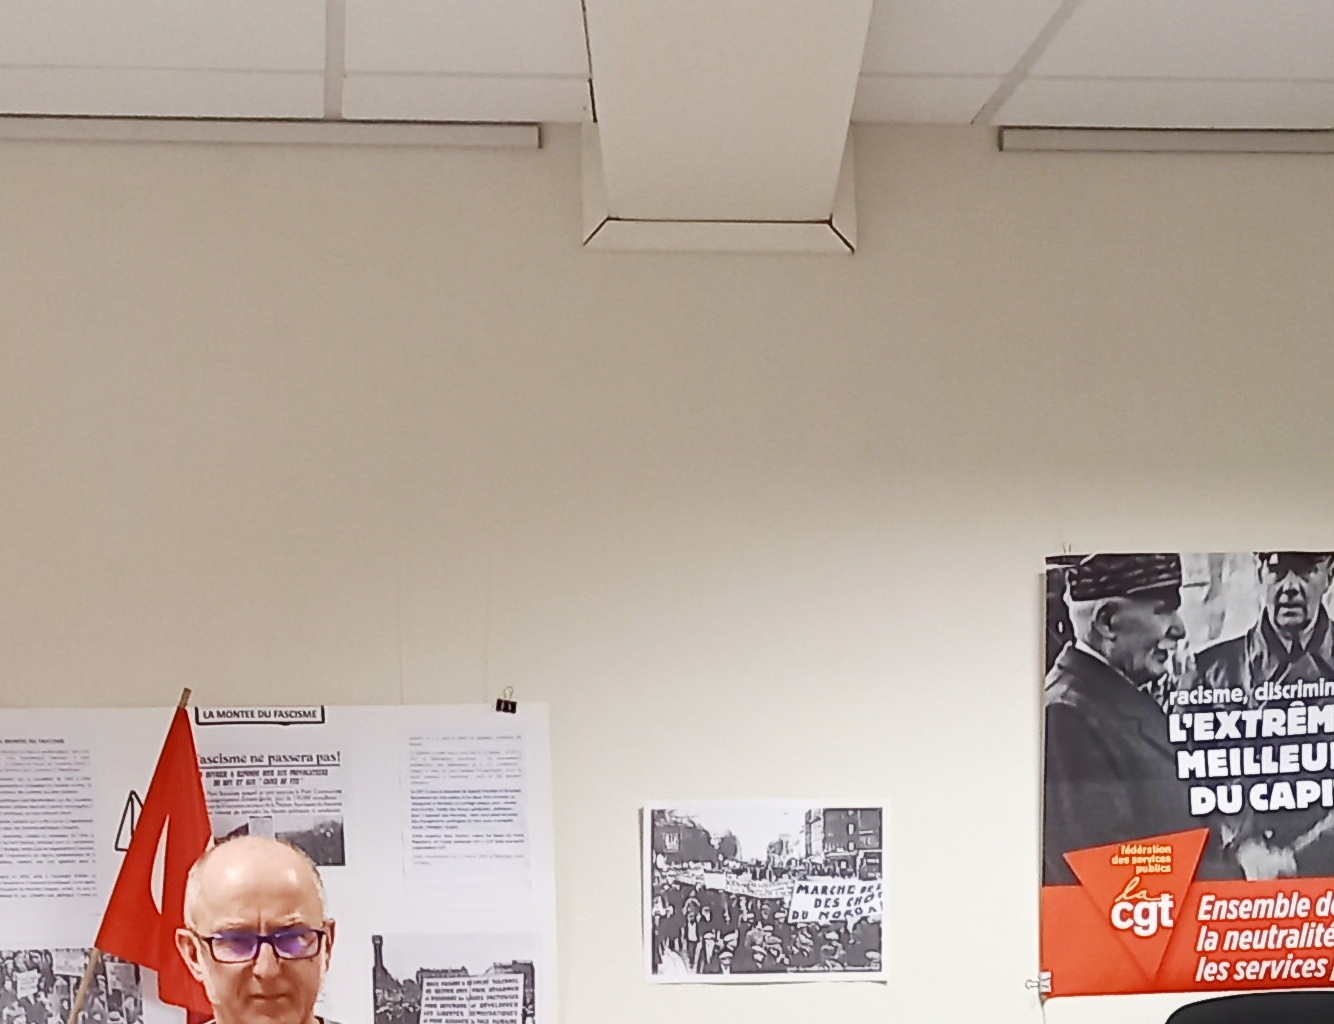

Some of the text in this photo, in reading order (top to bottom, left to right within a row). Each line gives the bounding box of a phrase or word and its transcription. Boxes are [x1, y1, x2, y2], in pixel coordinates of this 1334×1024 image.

[1170, 686, 1249, 705] racisme,
[203, 711, 214, 719] LA
[273, 710, 317, 718] FASCISME
[250, 755, 264, 763] ne
[268, 754, 313, 766] passera
[1190, 786, 1242, 815] DU
[796, 884, 855, 895] MARCHE
[792, 910, 808, 919] DU
[1111, 893, 1173, 936] cgt
[1198, 893, 1310, 920] Ensemble
[1196, 926, 1218, 951] la
[1196, 956, 1230, 981] les
[1233, 953, 1328, 981] services
